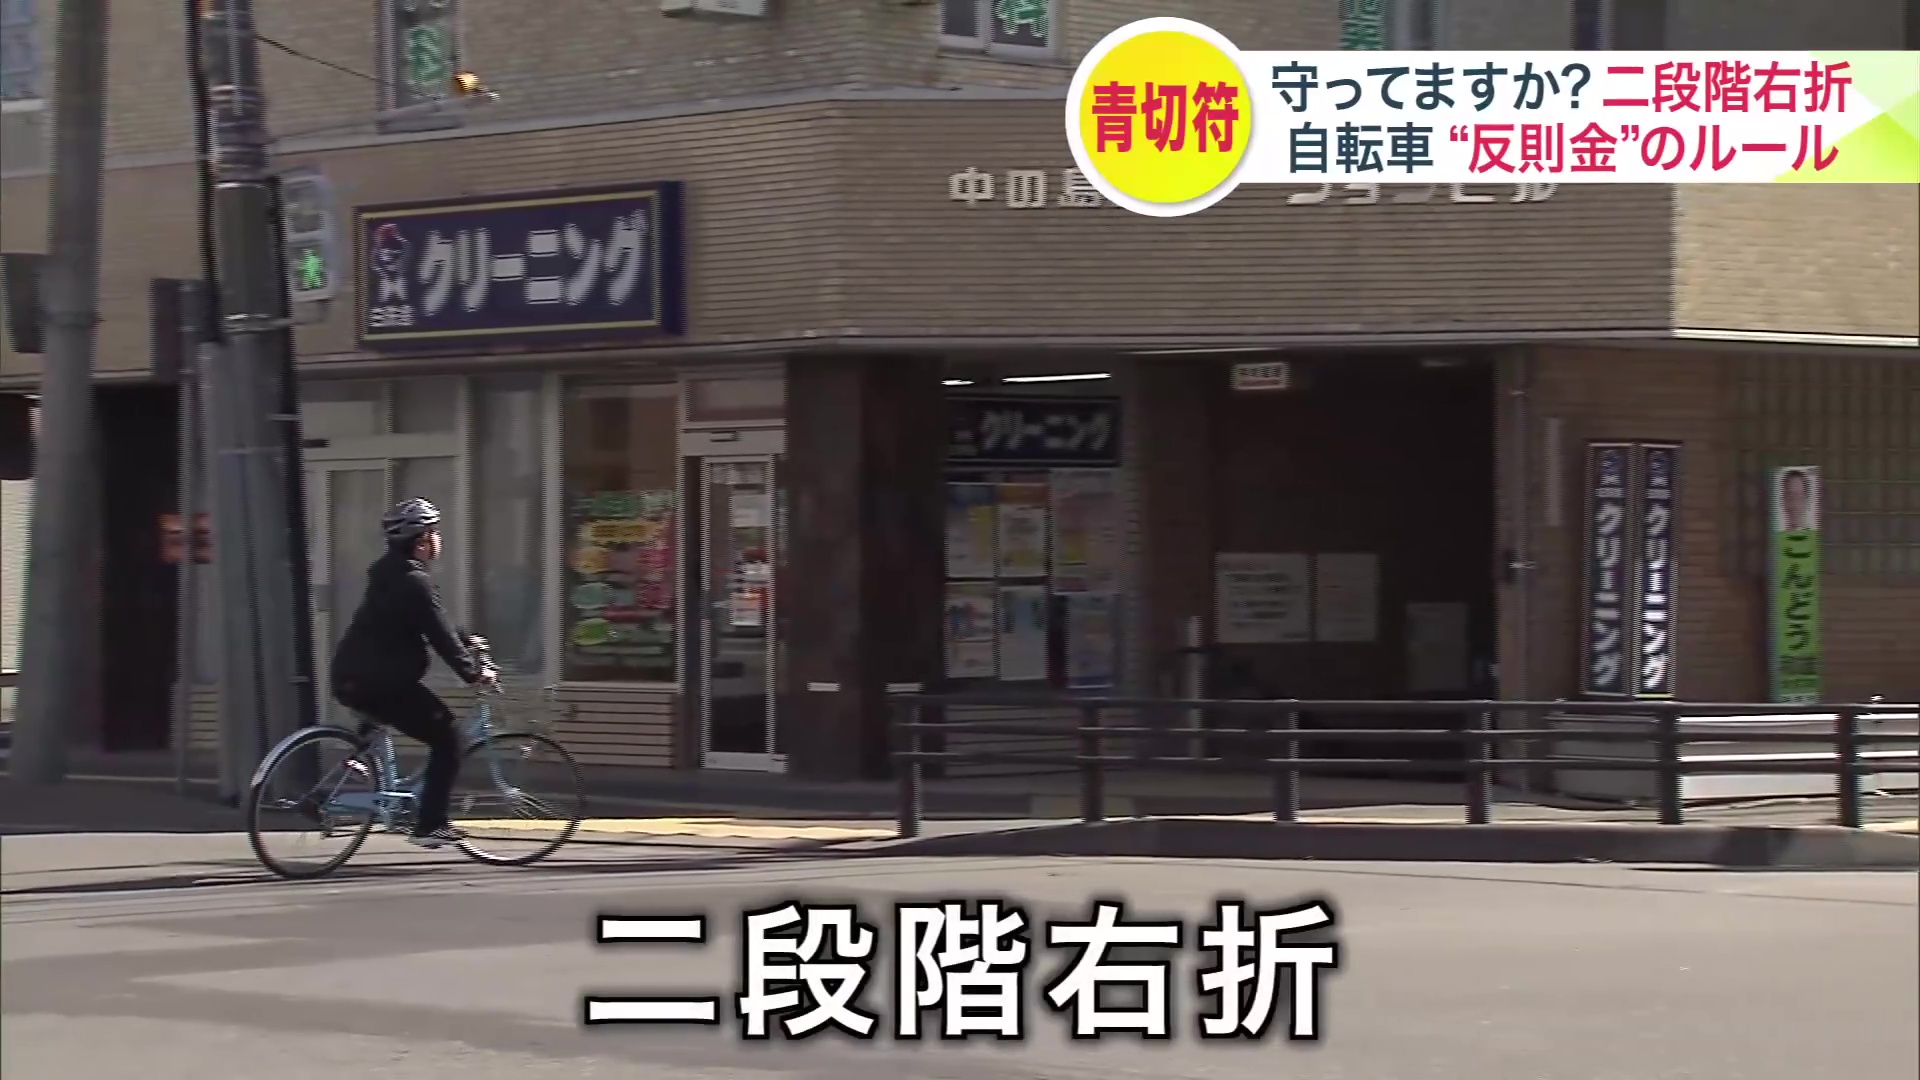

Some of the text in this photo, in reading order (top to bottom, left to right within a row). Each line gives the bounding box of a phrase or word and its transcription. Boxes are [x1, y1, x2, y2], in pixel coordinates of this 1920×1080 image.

[416, 208, 648, 316] クリーニング
[979, 411, 1112, 450] クリーニング
[1593, 502, 1624, 687] クリーニング
[1642, 503, 1671, 689] クリーニング
[1780, 533, 1814, 651] こんどう
